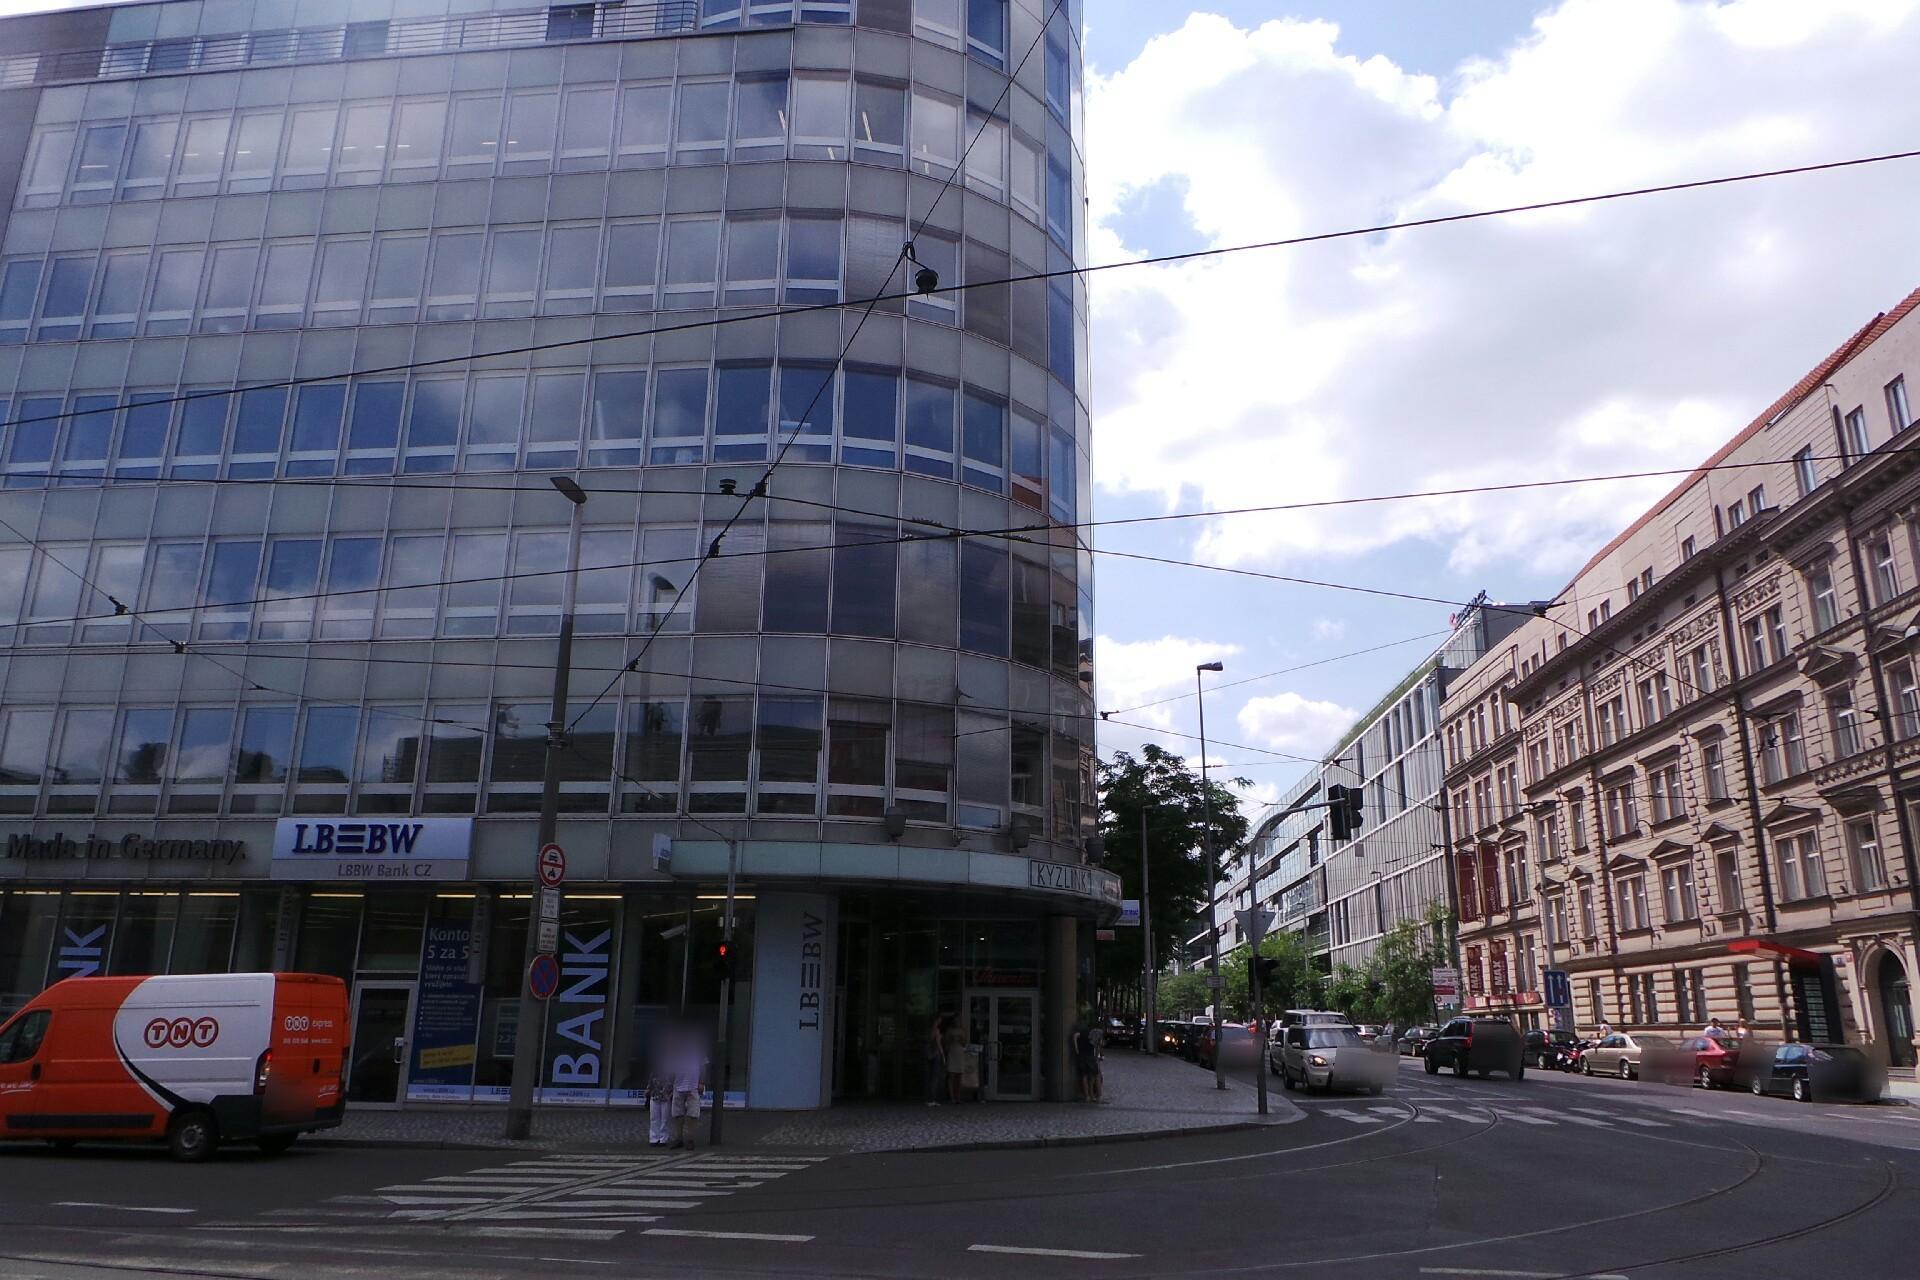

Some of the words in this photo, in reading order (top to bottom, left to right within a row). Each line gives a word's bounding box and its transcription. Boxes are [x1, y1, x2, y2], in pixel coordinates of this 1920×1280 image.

[7, 832, 77, 858] Made
[87, 833, 111, 859] in
[337, 864, 375, 878] LBBW
[377, 864, 410, 878] Bank
[413, 864, 434, 878] CZ
[430, 928, 470, 942] Konto
[426, 944, 437, 960] 5
[439, 947, 456, 960] za
[459, 944, 470, 960] 5
[551, 927, 613, 1084] BANK
[286, 1017, 309, 1030] TNT
[147, 1020, 216, 1045] TNT
